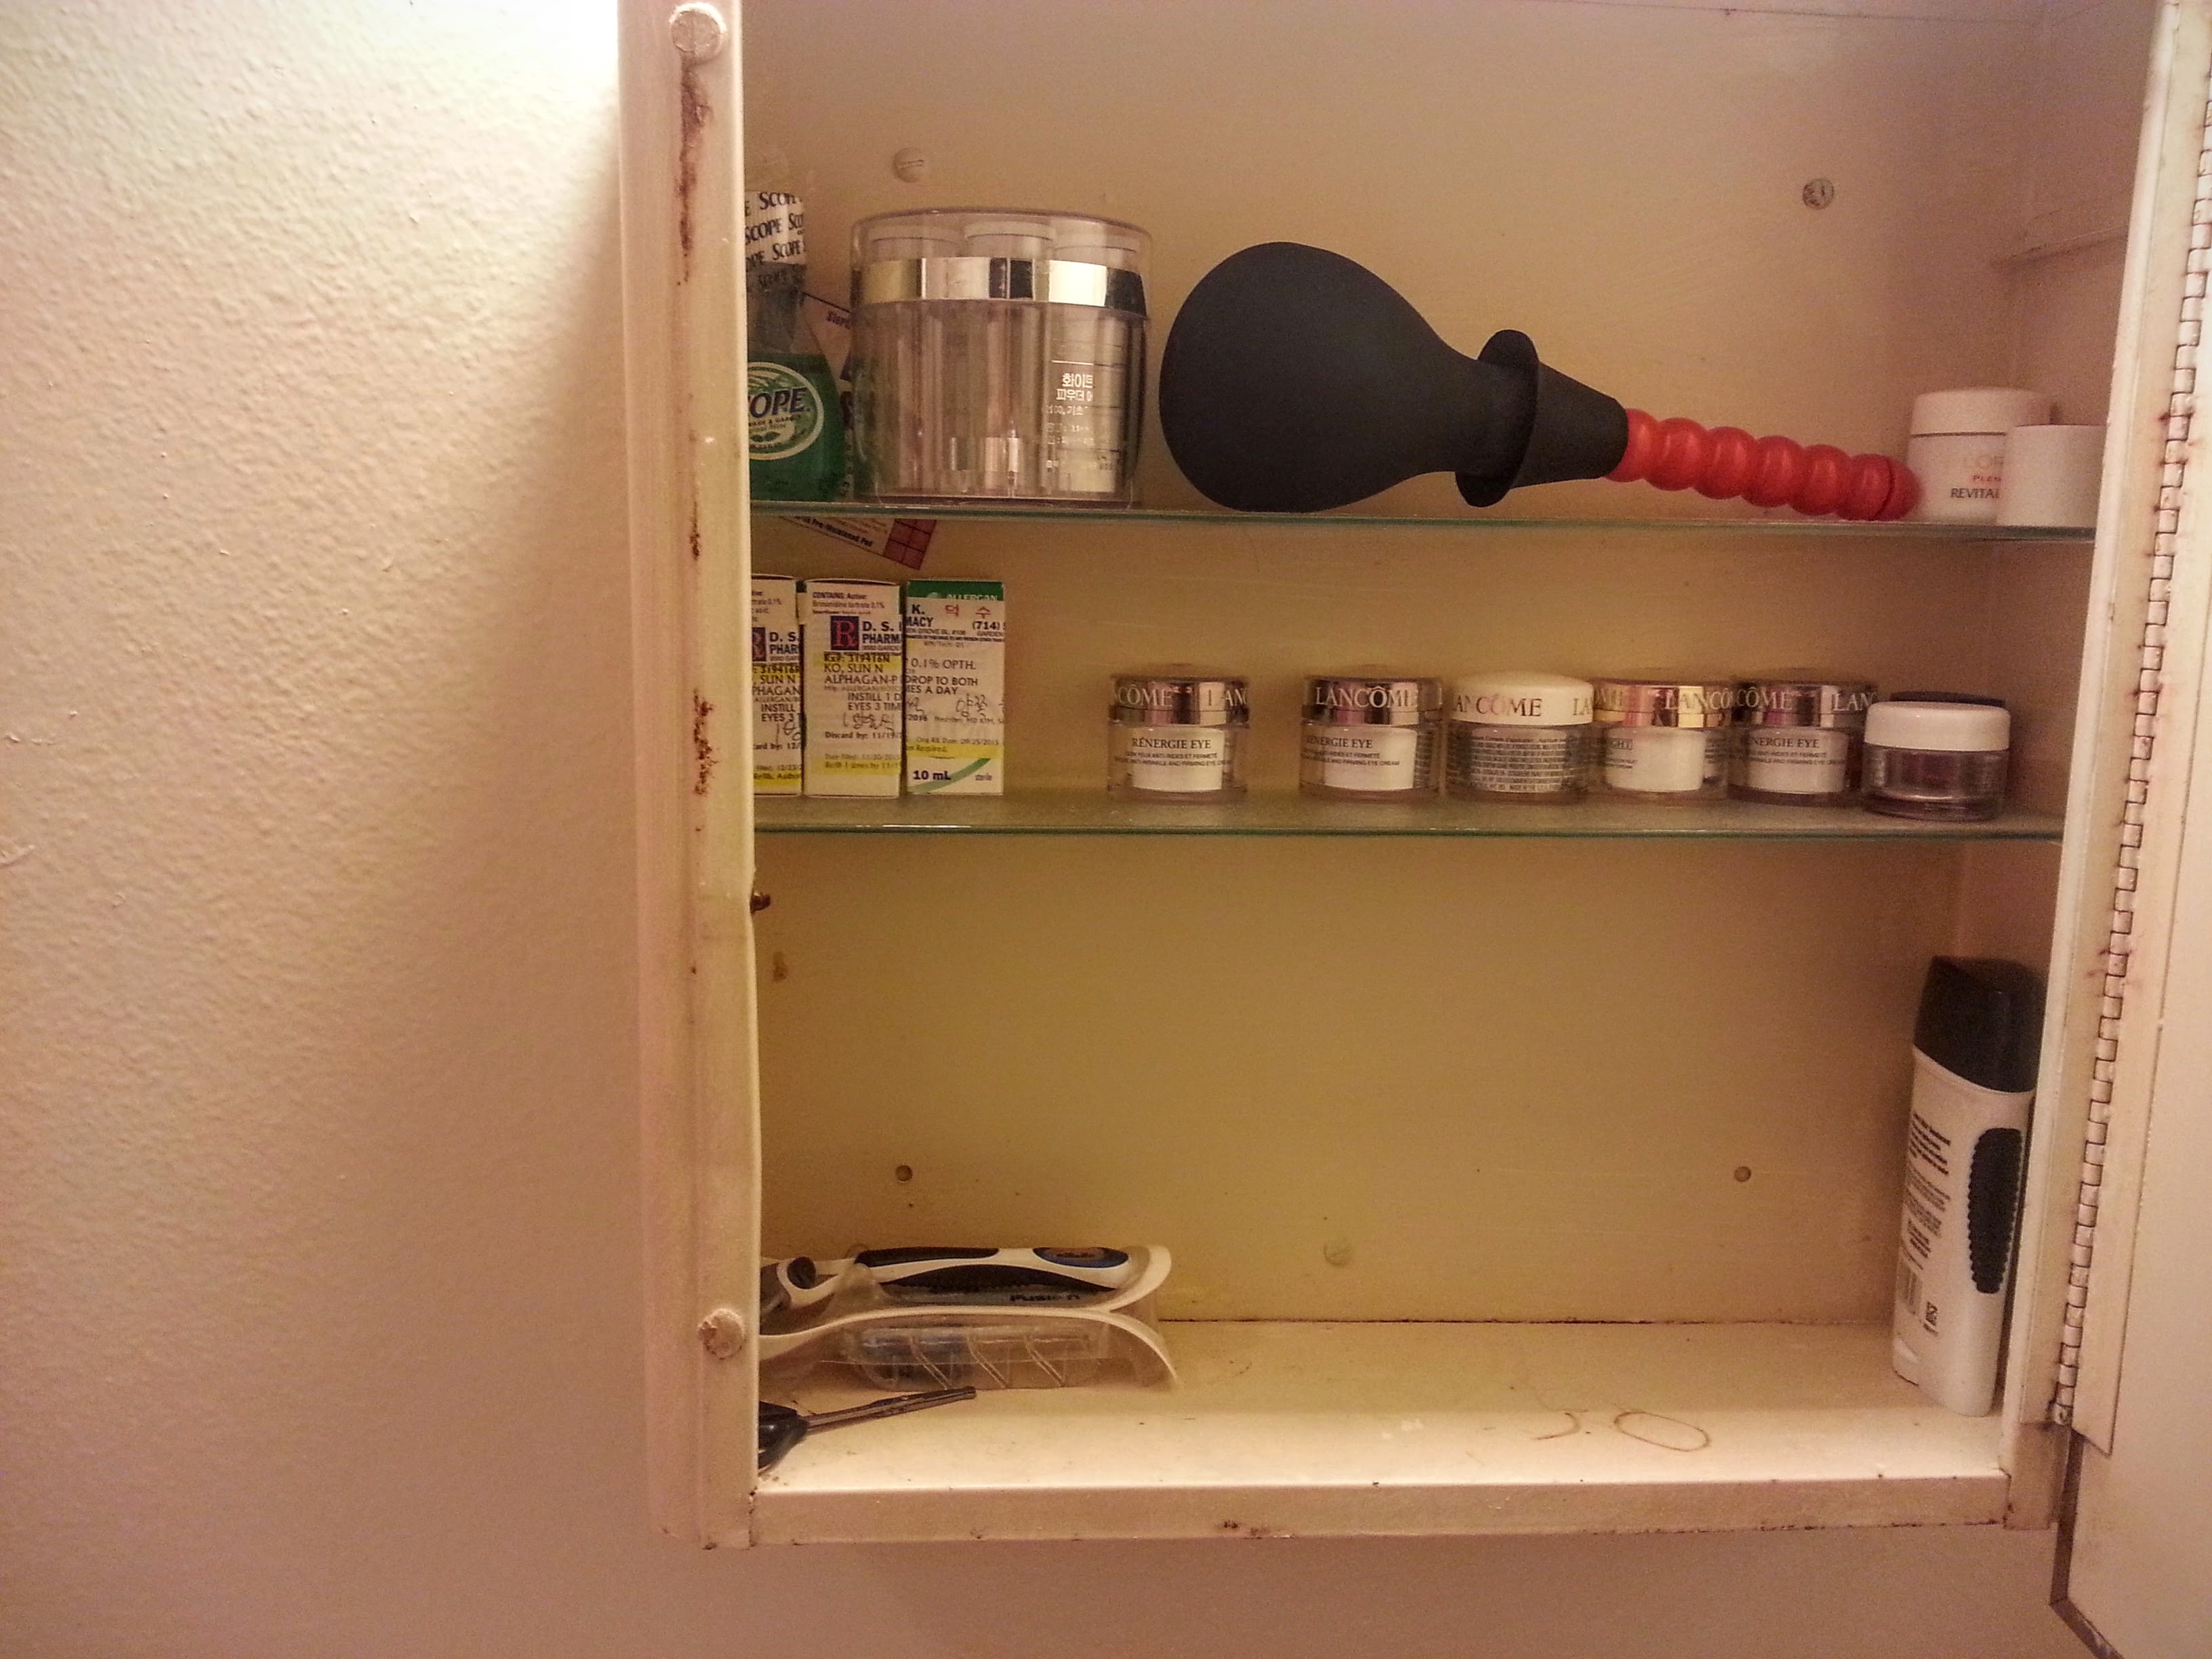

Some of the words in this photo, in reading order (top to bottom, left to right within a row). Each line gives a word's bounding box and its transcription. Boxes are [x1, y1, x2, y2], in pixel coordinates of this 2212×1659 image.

[1062, 373, 1093, 388] 화이트
[747, 386, 805, 418] OPE
[912, 605, 925, 615] K.
[863, 621, 876, 632] D.
[881, 621, 894, 632] S.
[972, 621, 1000, 630] (714)
[770, 632, 783, 642] D.
[824, 663, 844, 674] KO,
[848, 663, 871, 672] SUN
[875, 663, 883, 672] N
[912, 658, 940, 669] 0.1%
[943, 659, 976, 670] OPTH.
[760, 675, 783, 684] SUN
[824, 675, 898, 684] ALPHAGAN-P
[936, 676, 949, 685] TO
[952, 677, 978, 686] BOTH
[936, 687, 958, 695] DAY
[848, 692, 882, 701] INSTILL
[762, 703, 796, 712] INSTILL
[848, 702, 872, 710] EYES
[762, 713, 785, 722] EYES
[1132, 737, 1187, 749] RÉNERGIE
[1191, 739, 1211, 749] EYE
[1351, 739, 1373, 749] EYE
[1797, 739, 1820, 748] EYE
[913, 771, 928, 780] 10
[933, 771, 951, 780] mL
